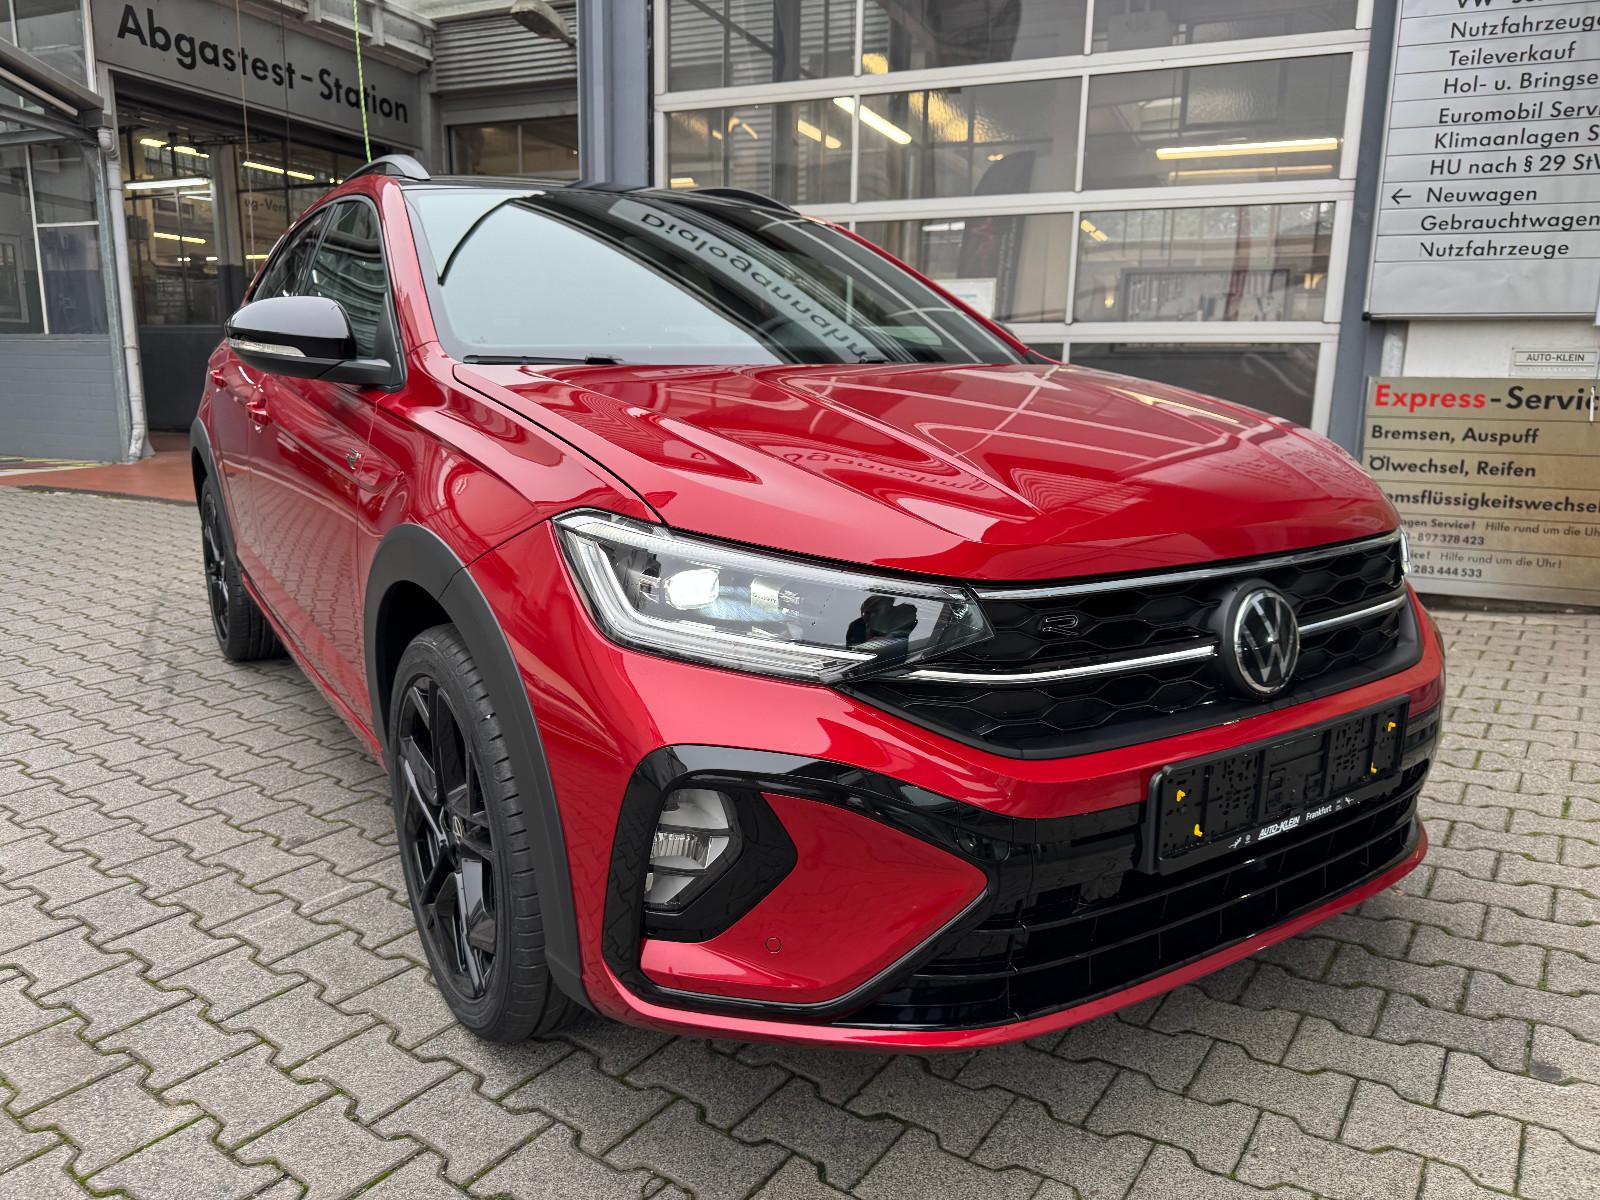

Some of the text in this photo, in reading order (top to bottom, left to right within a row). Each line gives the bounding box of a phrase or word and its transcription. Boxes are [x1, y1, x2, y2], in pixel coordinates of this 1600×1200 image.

[116, 4, 409, 123] Abgastest-Station
[1449, 41, 1576, 66] Teileverkauf
[1443, 72, 1599, 94] Hol- u. Bringse
[1439, 101, 1543, 124] Euromobil
[1434, 128, 1579, 149] Klimaanlagen
[1430, 158, 1462, 175] HU
[1468, 156, 1517, 174] nach
[1523, 155, 1533, 173] §
[1539, 154, 1565, 172] 29
[1426, 187, 1537, 206] Neuwagen
[1420, 211, 1600, 231] Gebrauchtwagen
[1420, 240, 1569, 259] Nutzfahrzeuge
[1526, 353, 1585, 362] AUTO-KLEIN
[1371, 425, 1540, 446] Bremsen, Auspuff
[1369, 455, 1537, 477] Ölwechsel, Reifen
[1485, 521, 1510, 532] Hilfe
[1514, 523, 1539, 534] rund
[1543, 527, 1560, 535] um
[1564, 525, 1581, 536] die
[1440, 551, 1464, 562] Hilfe
[1467, 553, 1492, 565] rund
[1496, 557, 1513, 565] um
[1516, 556, 1533, 567] die
[1258, 816, 1300, 840] AUTO-KLEIN
[1305, 804, 1332, 820] Frankfurt
